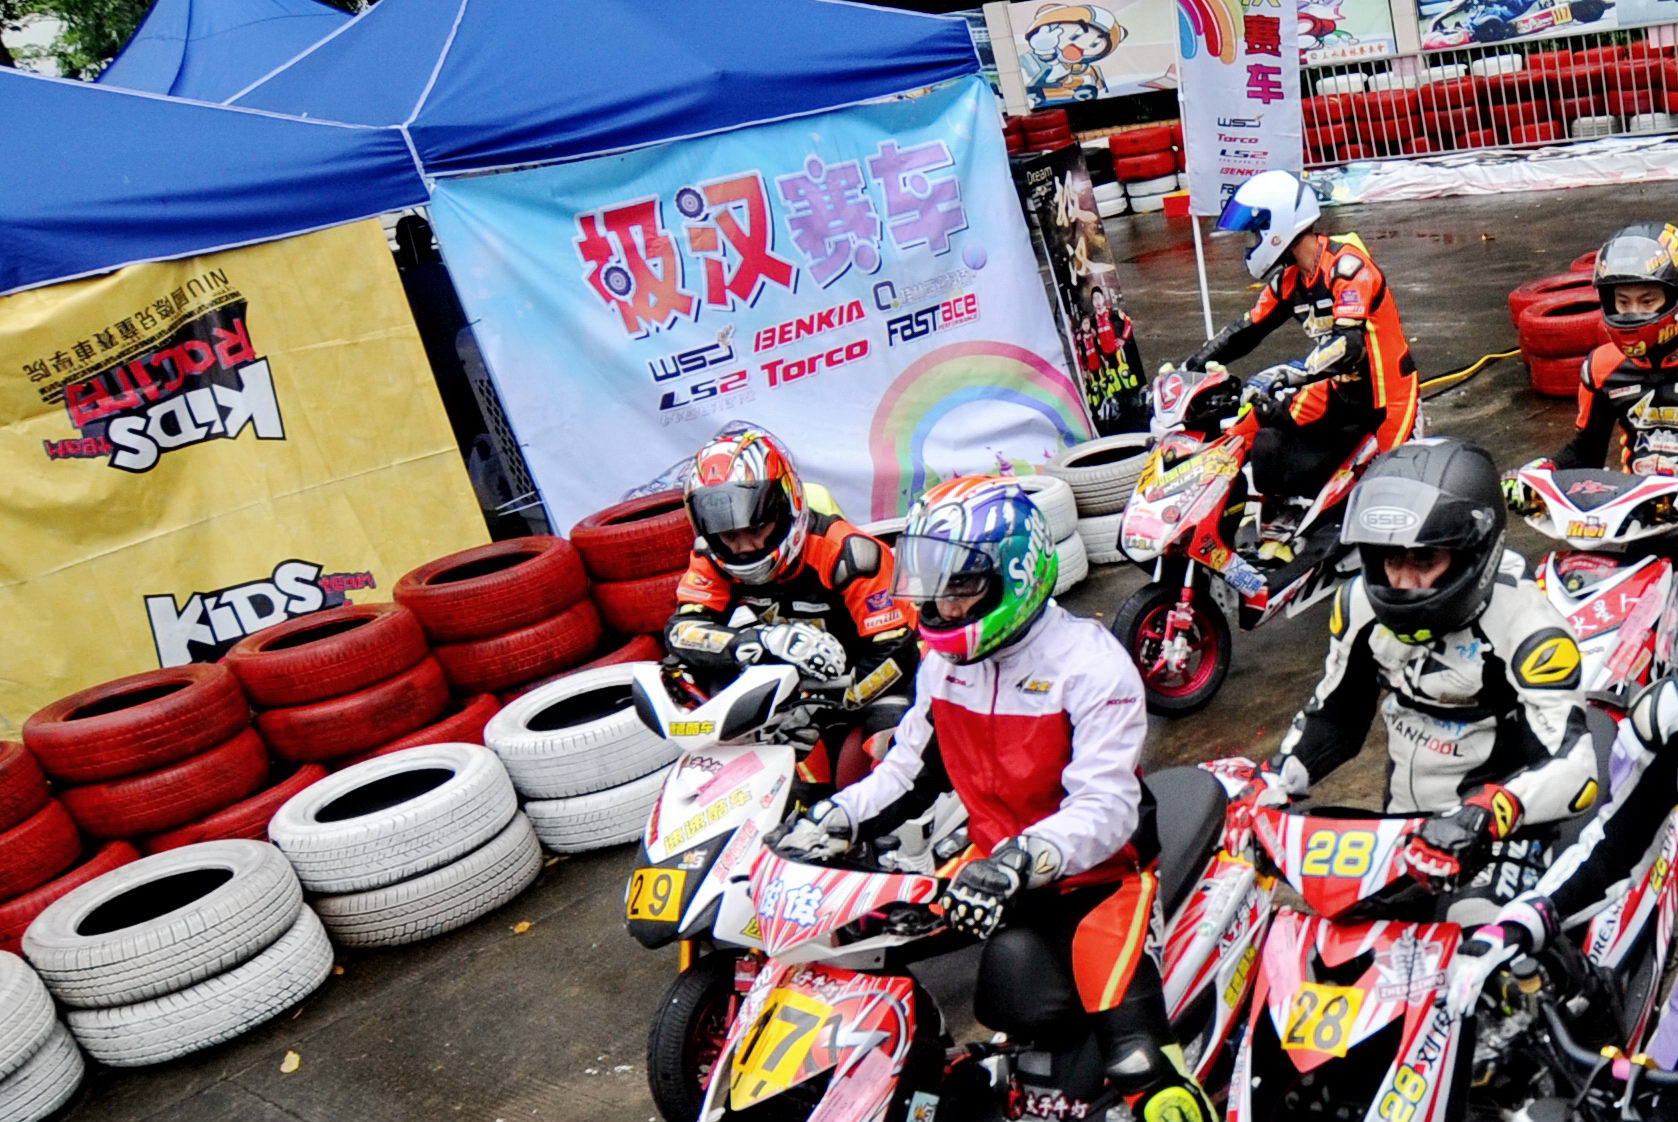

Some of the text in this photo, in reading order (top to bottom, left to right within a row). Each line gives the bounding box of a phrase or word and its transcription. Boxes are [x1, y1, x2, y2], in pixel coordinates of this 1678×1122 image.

[1217, 133, 1259, 144] Torco
[1219, 149, 1269, 159] LS2
[1026, 166, 1053, 185] Dream
[577, 141, 968, 338] 极汉赛车
[753, 299, 866, 353] BENKIA
[760, 339, 869, 388] Torco
[659, 369, 749, 411] LS2
[1365, 513, 1408, 526] GSB
[1566, 520, 1607, 540] Kiwi
[1301, 830, 1377, 877] 28
[629, 873, 674, 917] 29
[1286, 990, 1350, 1051] 28
